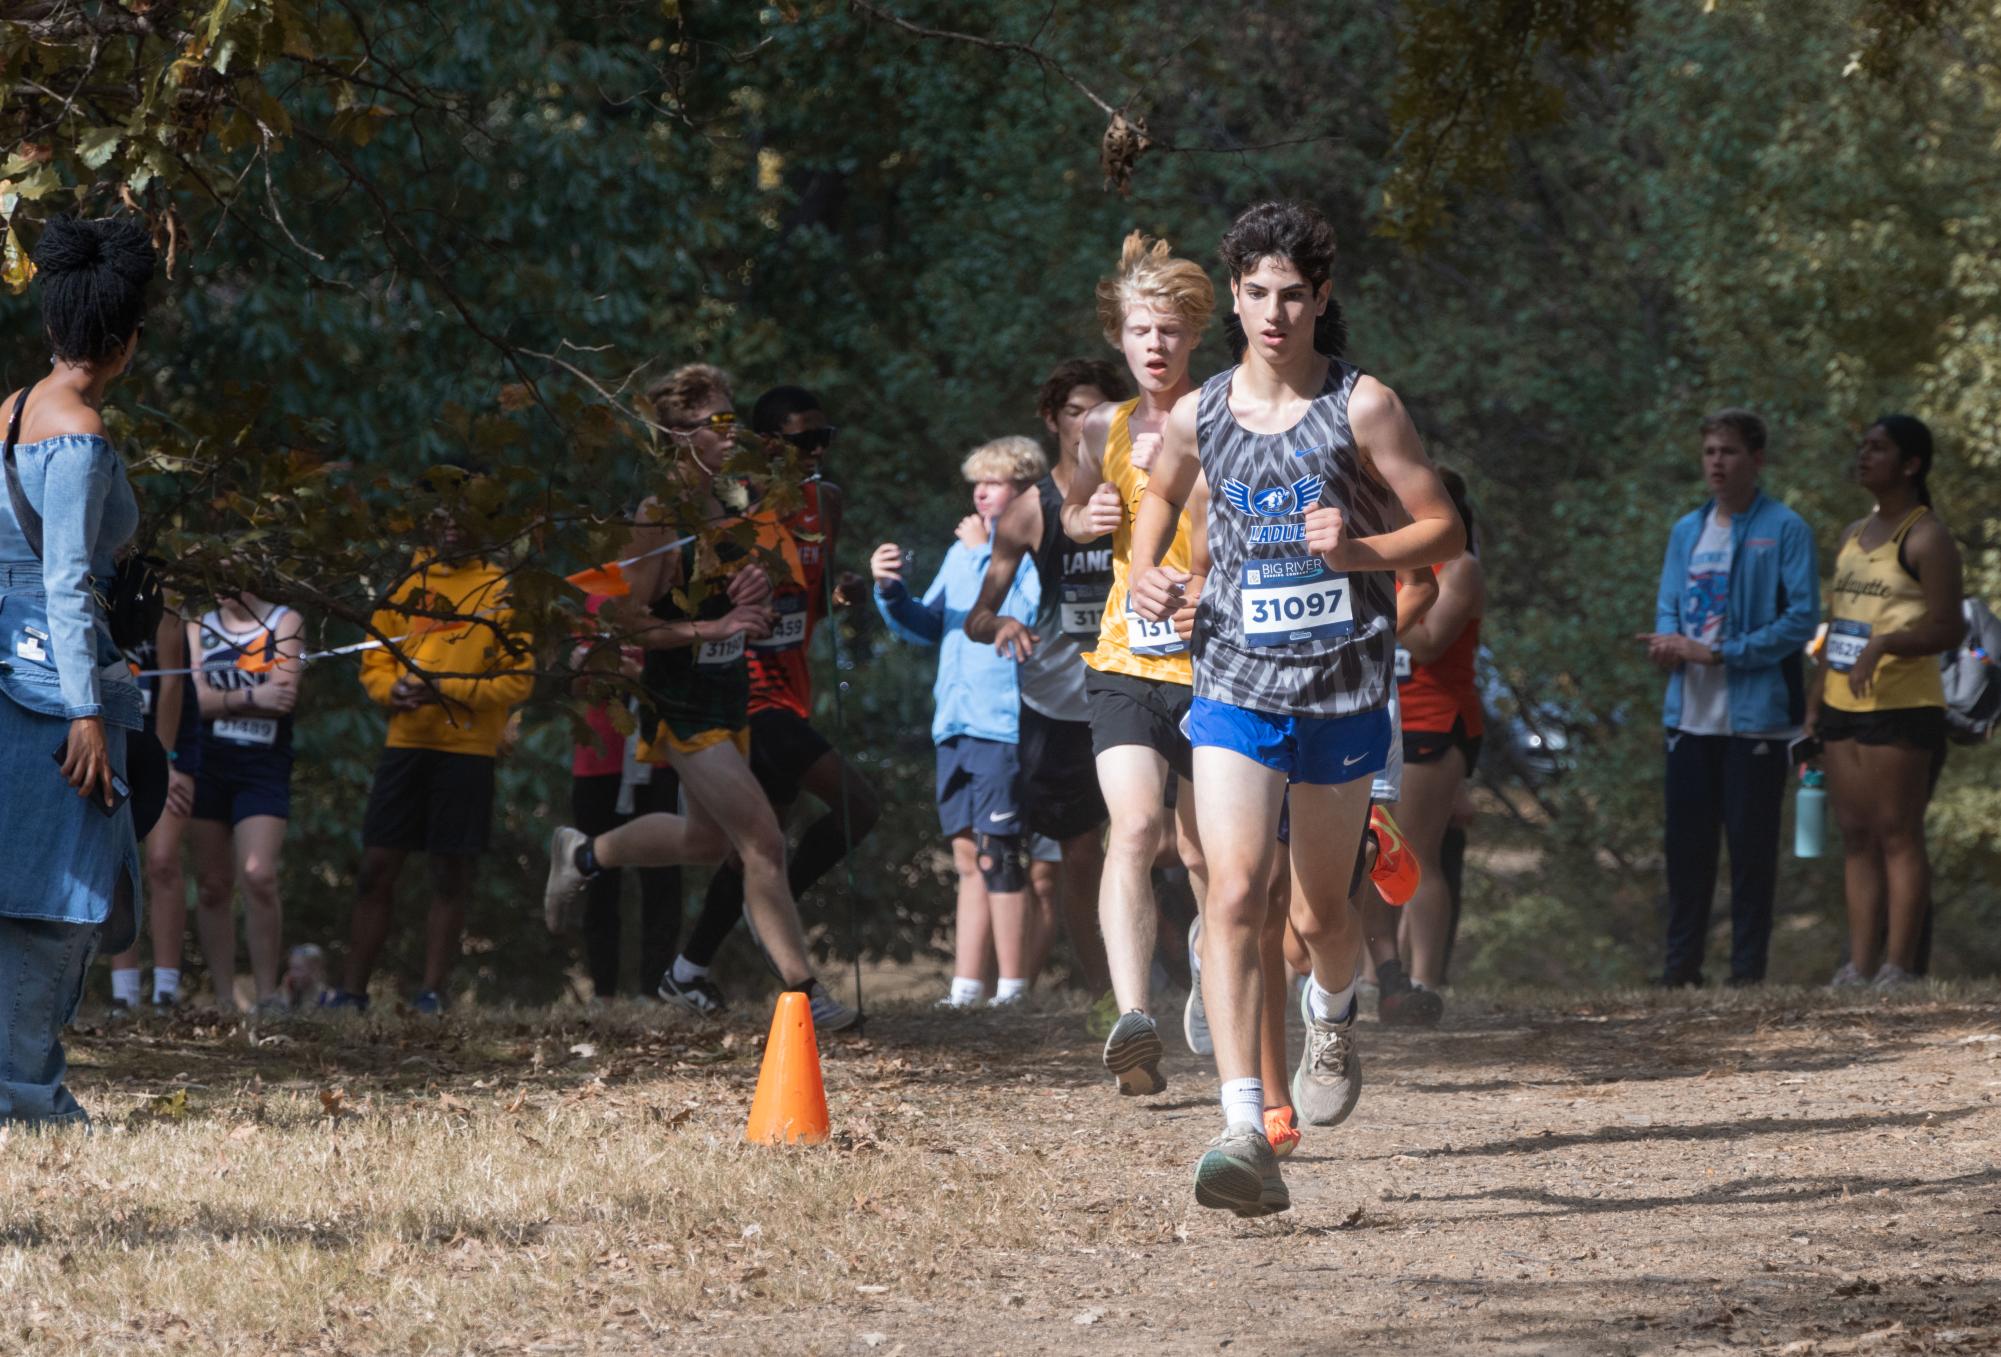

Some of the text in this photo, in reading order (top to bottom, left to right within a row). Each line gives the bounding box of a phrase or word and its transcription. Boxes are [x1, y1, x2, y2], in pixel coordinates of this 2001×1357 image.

[1262, 558, 1322, 575] BIG RIVER
[1251, 588, 1343, 623] 31097
